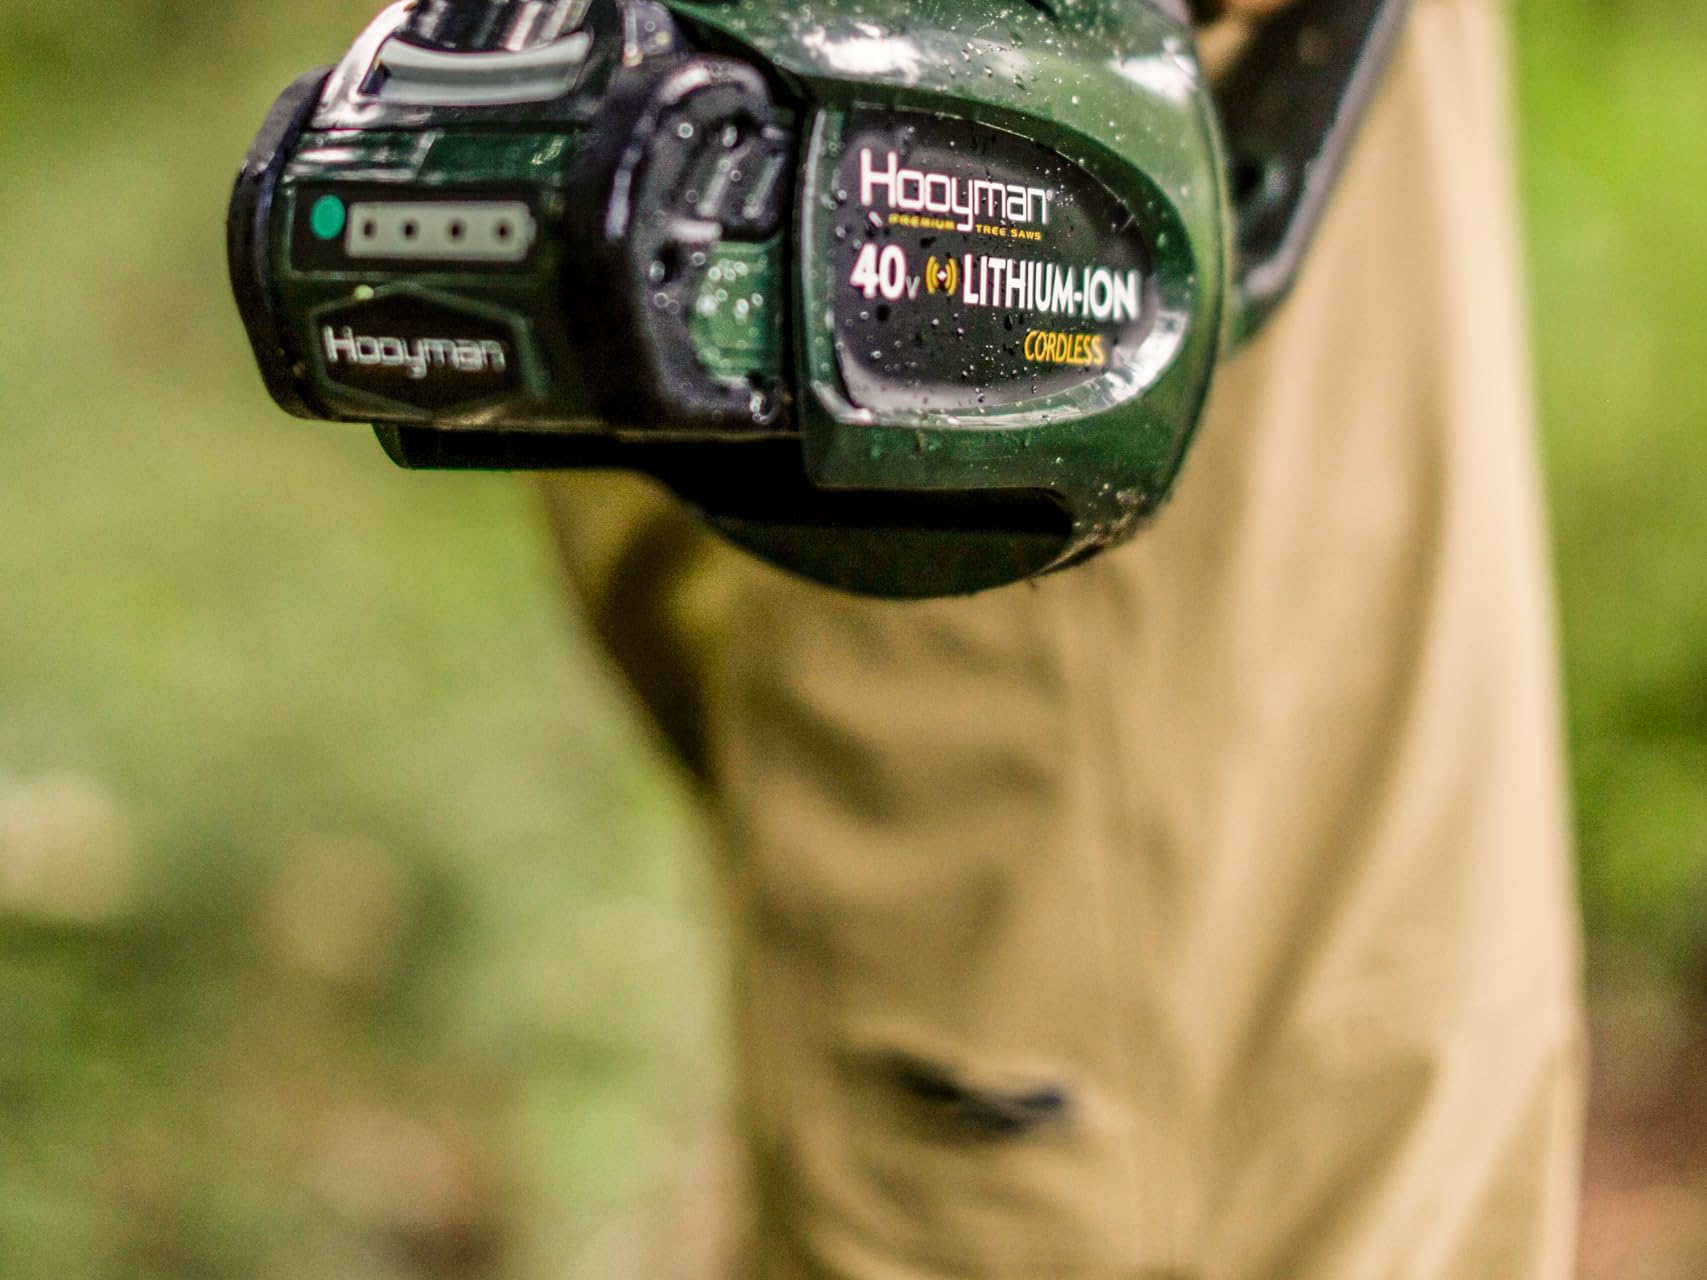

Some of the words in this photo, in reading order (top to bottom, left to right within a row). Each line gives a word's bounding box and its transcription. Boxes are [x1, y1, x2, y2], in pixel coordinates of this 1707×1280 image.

[859, 148, 1047, 231] Hooyman
[888, 213, 955, 231] PREMIUM
[975, 224, 1007, 237] TREE
[1010, 228, 1042, 241] SAWS
[963, 254, 1139, 319] LITHIUM-ION
[322, 325, 506, 378] Hooyman
[1024, 329, 1104, 366] CORDLESS
